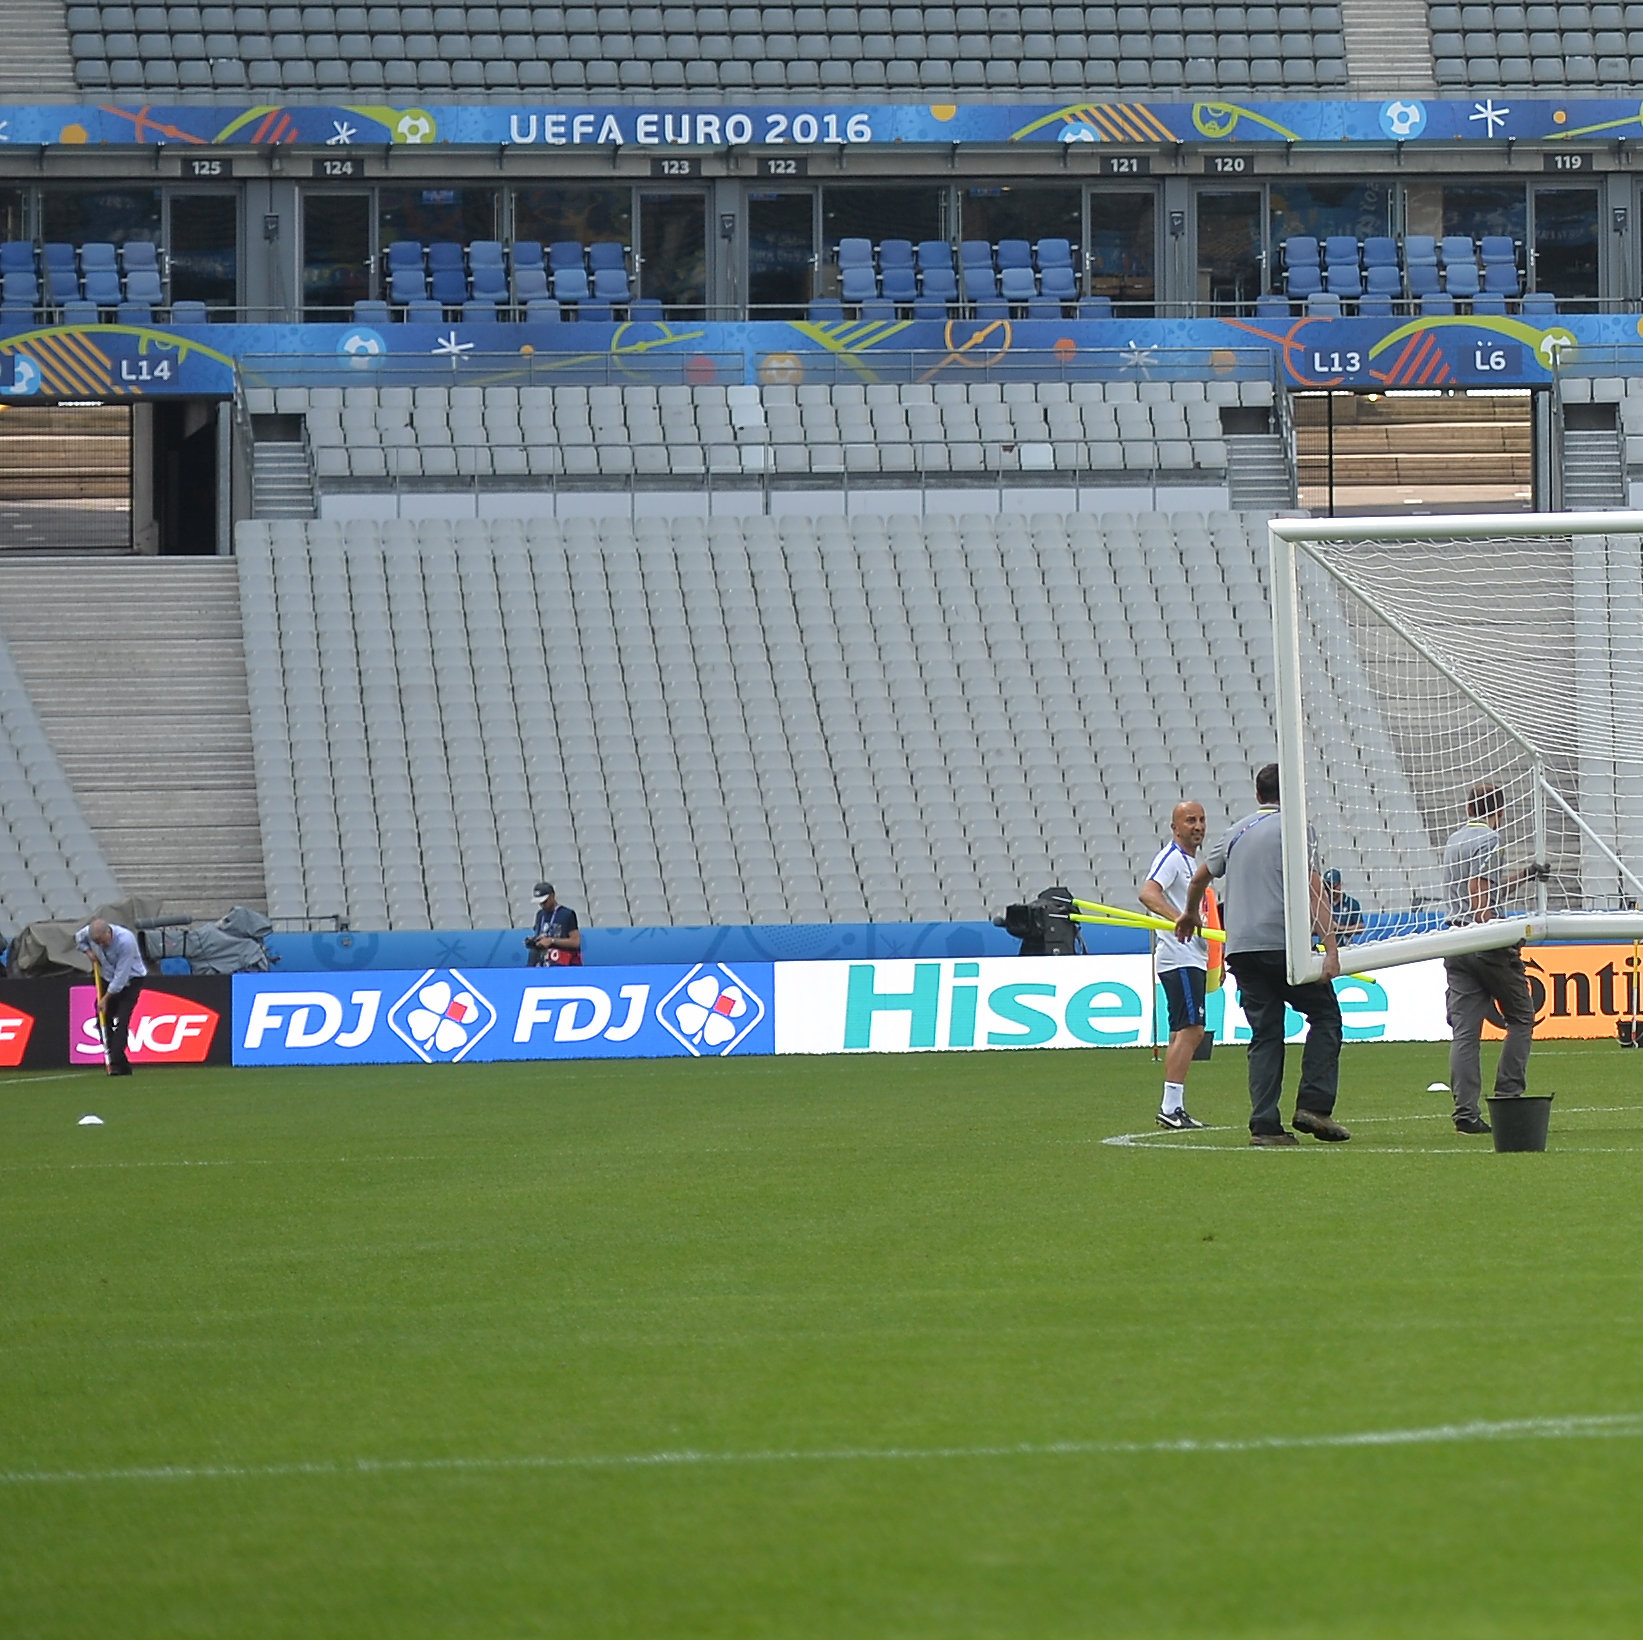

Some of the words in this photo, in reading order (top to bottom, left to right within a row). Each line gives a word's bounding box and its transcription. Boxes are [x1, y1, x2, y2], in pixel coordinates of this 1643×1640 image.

[511, 115, 623, 145] UEFA
[637, 114, 752, 145] EURO
[766, 114, 871, 143] 2016
[193, 162, 220, 174] 125
[324, 162, 352, 174] 124
[662, 161, 689, 174] 123
[768, 161, 796, 173] 122
[1111, 159, 1137, 172] 121
[1215, 159, 1244, 171] 120
[1555, 156, 1581, 169] 119
[1315, 353, 1360, 371] L13
[1476, 351, 1505, 370] L6
[122, 360, 171, 380] L14
[244, 991, 381, 1048] FDJ
[514, 985, 649, 1042] FDJ
